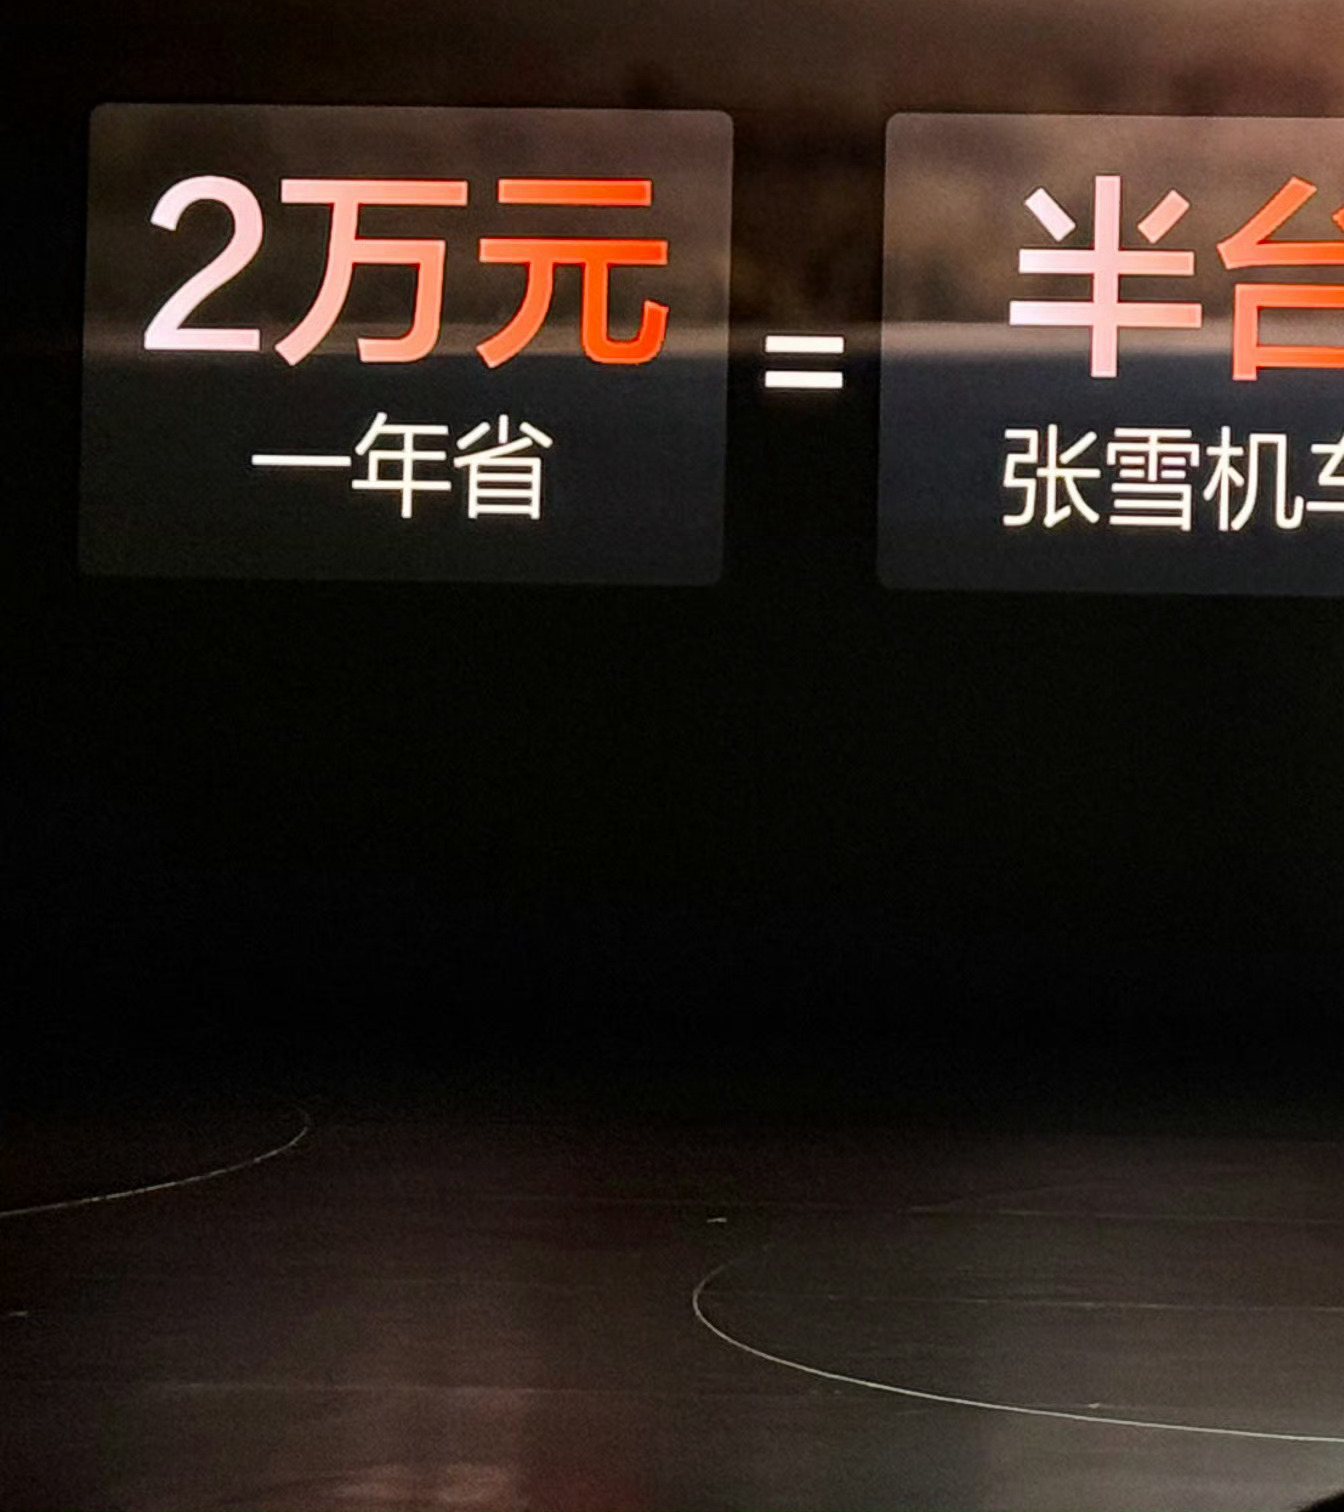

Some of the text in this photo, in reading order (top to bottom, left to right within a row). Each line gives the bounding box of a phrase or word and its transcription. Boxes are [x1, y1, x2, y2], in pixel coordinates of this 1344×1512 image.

[142, 172, 670, 371] 2万元
[250, 411, 554, 520] 一年省
